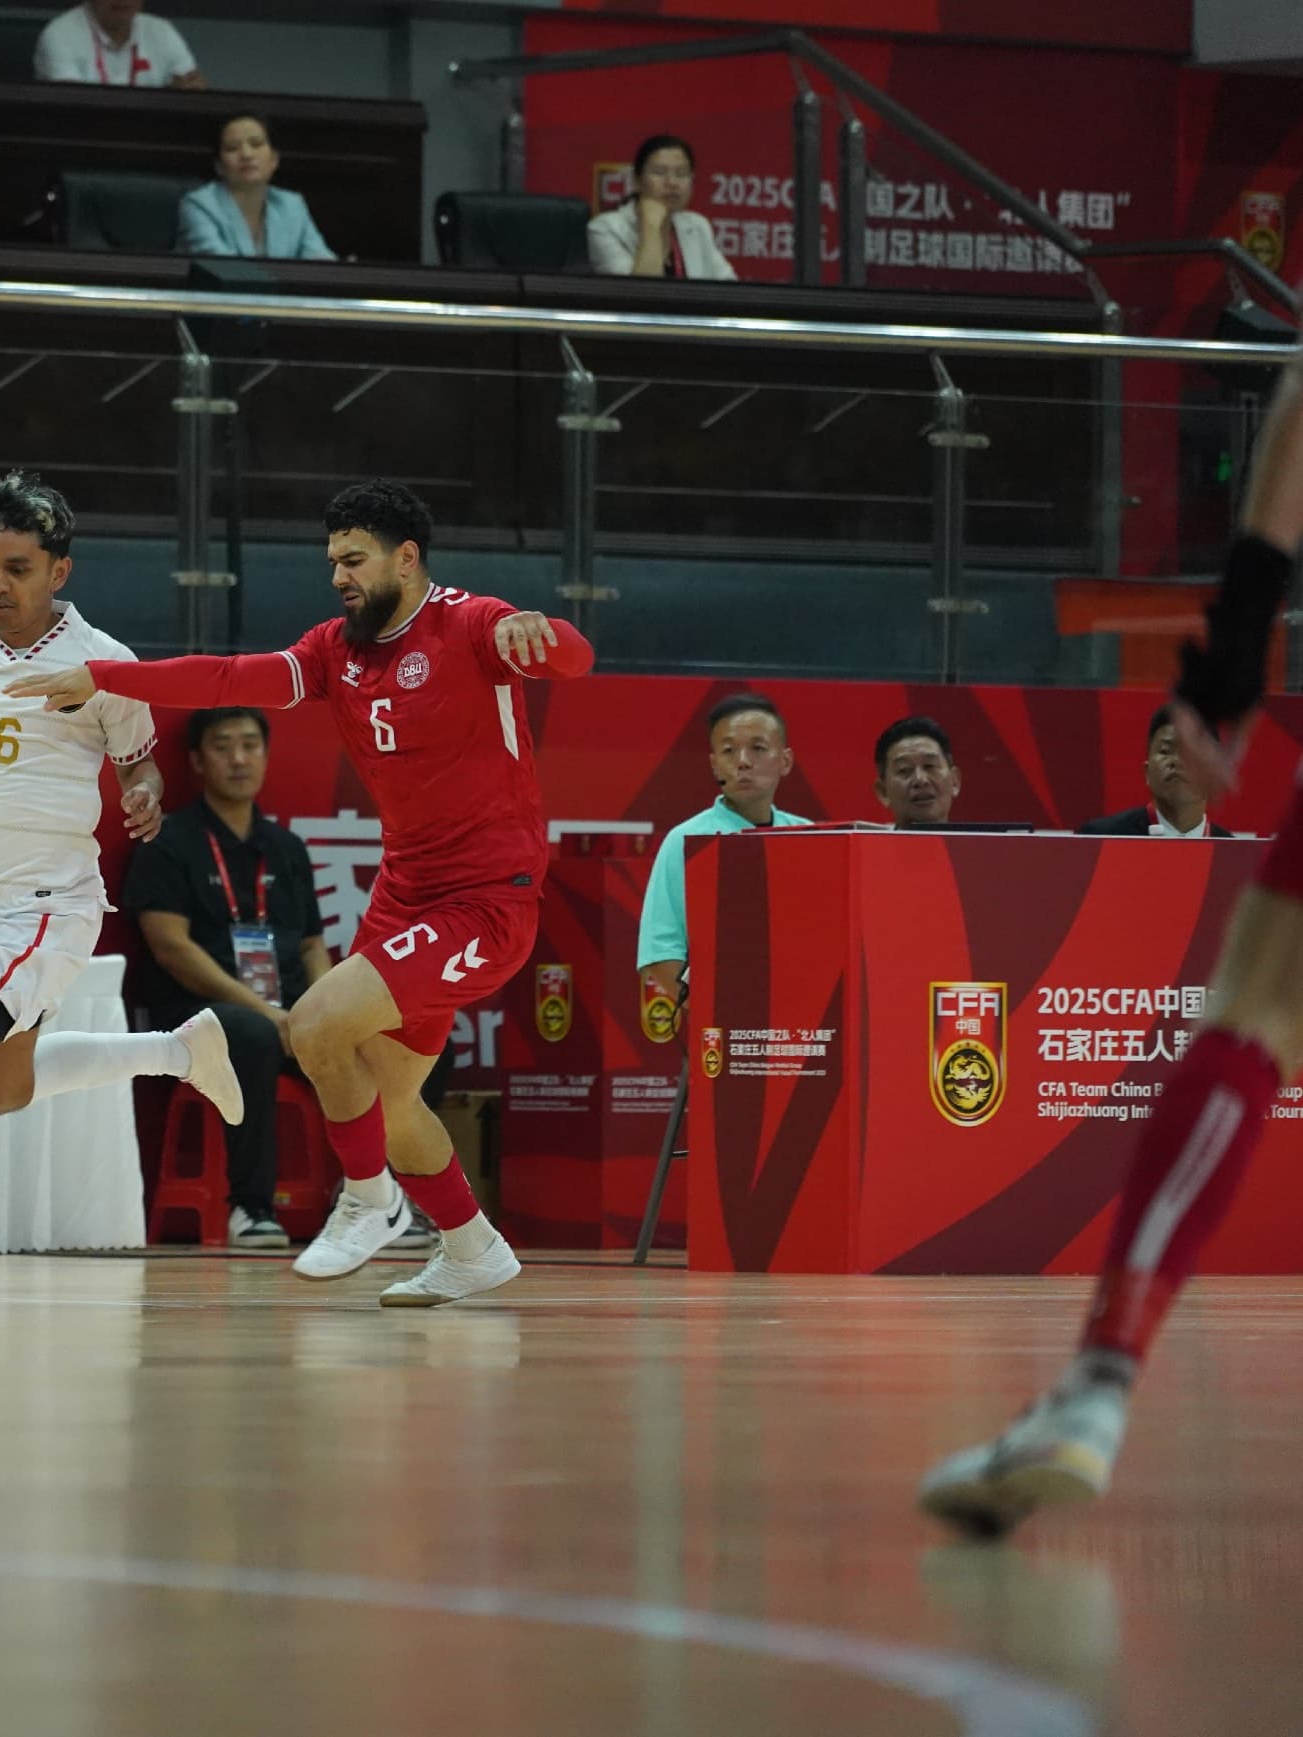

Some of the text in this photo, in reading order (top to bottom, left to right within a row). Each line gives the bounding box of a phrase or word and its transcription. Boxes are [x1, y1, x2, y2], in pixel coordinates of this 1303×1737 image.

[370, 698, 397, 752] 6
[381, 922, 439, 961] 6
[936, 992, 1000, 1017] CFA
[1037, 985, 1207, 1018] 2025CFA中国
[955, 1018, 981, 1035] 中国
[1037, 1081, 1066, 1097] CFA
[1070, 1081, 1108, 1097] Team
[1110, 1080, 1152, 1098] China
[1037, 1101, 1128, 1121] Shijiazhuang
